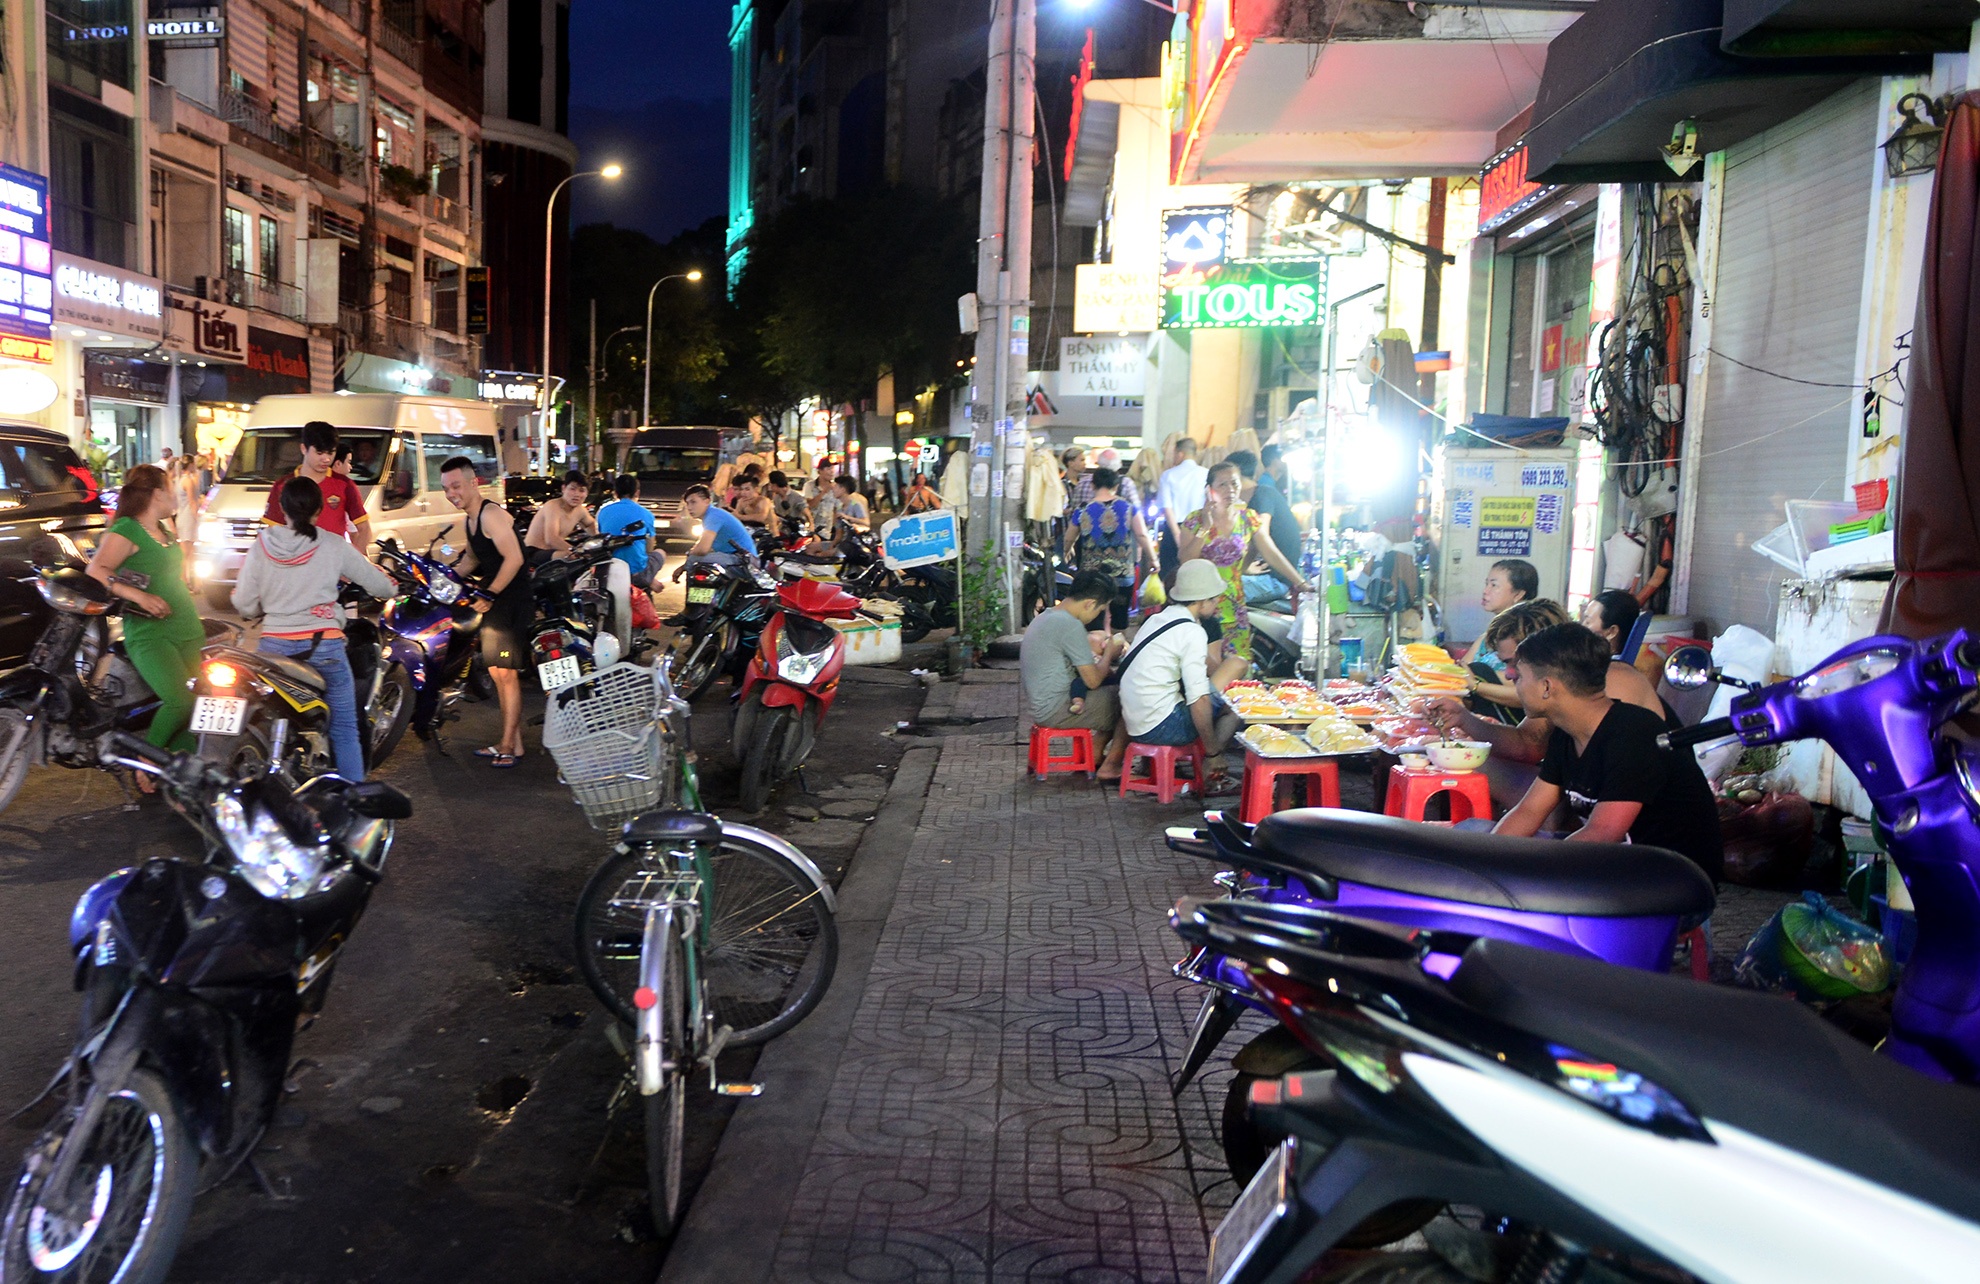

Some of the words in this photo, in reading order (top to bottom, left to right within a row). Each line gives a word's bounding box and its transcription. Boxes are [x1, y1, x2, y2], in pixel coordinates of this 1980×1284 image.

[147, 21, 220, 36] HOTEL
[1172, 283, 1316, 322] TOUS
[1066, 341, 1106, 357] BỆNH
[889, 526, 951, 548] mobifone
[202, 698, 239, 715] 55-P6
[198, 714, 236, 731] 5102
